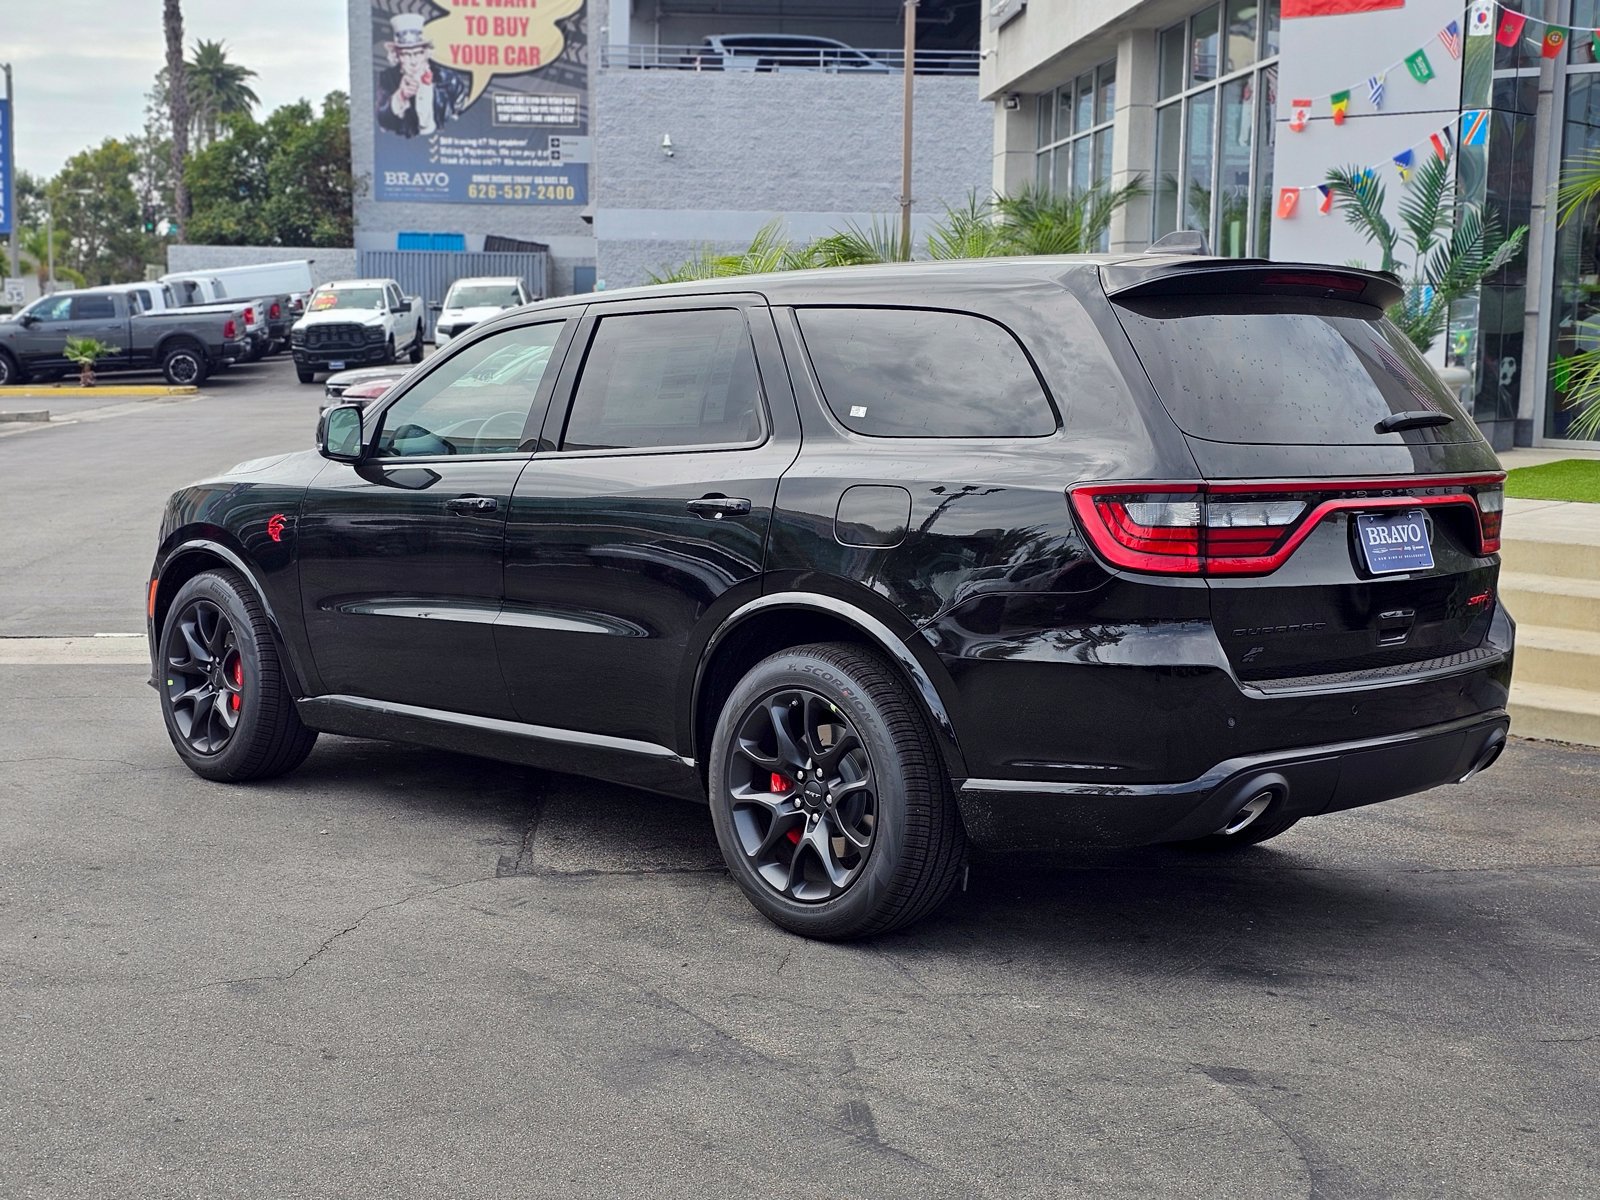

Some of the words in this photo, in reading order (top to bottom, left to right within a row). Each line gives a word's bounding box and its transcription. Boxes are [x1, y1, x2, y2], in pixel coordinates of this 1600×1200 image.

[465, 16, 488, 36] TO
[493, 16, 530, 36] BUY
[450, 44, 499, 65] YOUR
[504, 45, 541, 65] CAR
[384, 172, 449, 187] BRAVO
[468, 184, 575, 200] 626-537-2400
[1366, 524, 1421, 545] BRAVO
[1232, 622, 1327, 636] DURANGO
[802, 664, 875, 723] SCORPION
